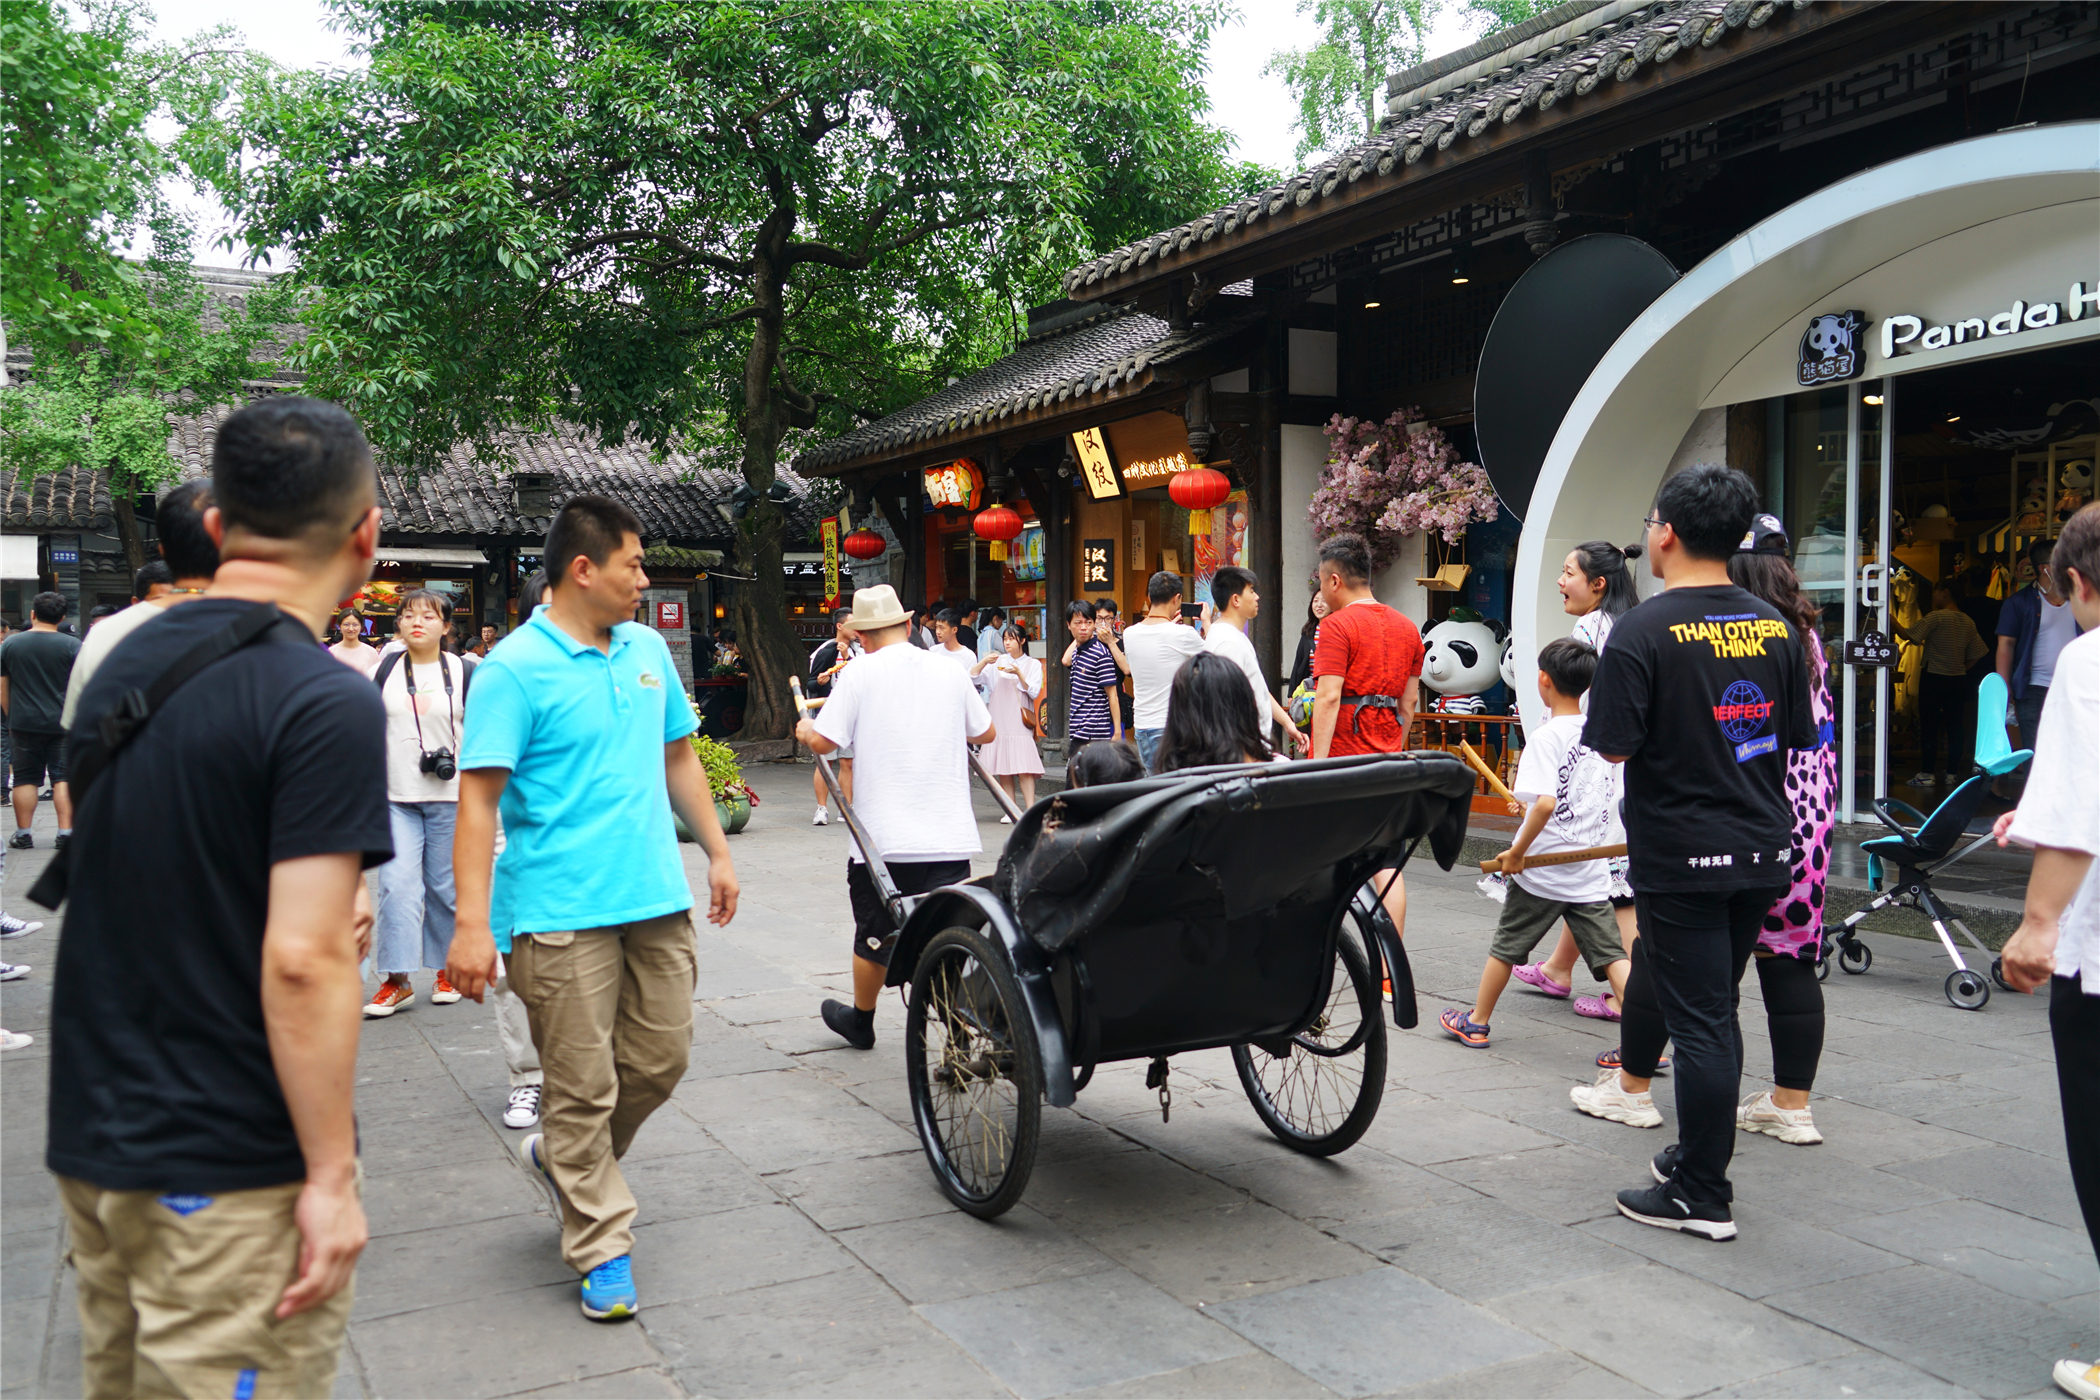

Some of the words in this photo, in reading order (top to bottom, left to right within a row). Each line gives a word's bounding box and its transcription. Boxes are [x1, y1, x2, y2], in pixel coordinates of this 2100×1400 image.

[1881, 300, 2061, 359] Panda
[1803, 355, 1850, 379] 熊猫屋
[825, 537, 836, 595] 铁板大鱿鱼
[1669, 622, 1723, 643] THAN
[1724, 619, 1789, 640] OTHERS
[1709, 637, 1767, 658] THINK
[1853, 646, 1890, 658] 营业中
